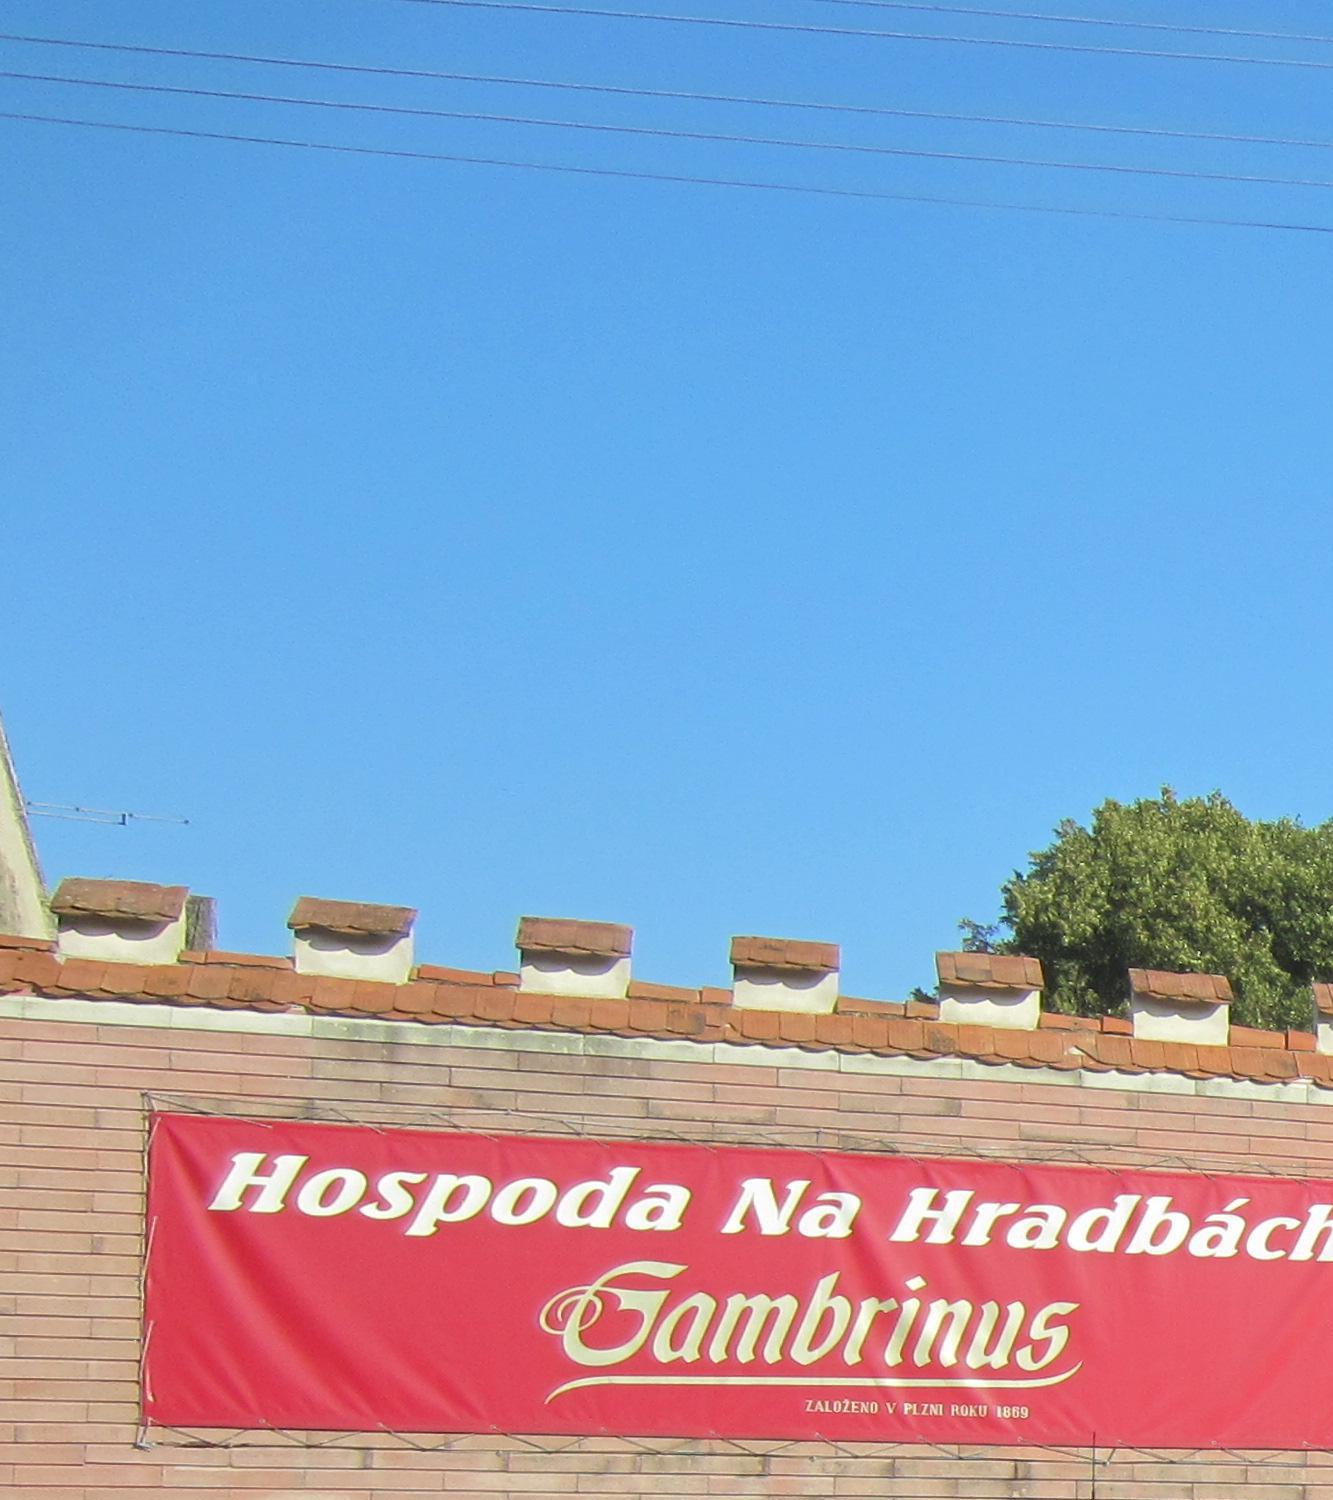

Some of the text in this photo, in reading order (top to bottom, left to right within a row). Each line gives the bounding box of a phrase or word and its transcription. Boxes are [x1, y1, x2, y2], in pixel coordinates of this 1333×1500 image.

[208, 1152, 693, 1238] Hospoda
[721, 1177, 863, 1240] Na
[541, 1259, 1082, 1373] Gambrinus
[805, 1399, 1029, 1419] ZALOŽENO V PLZNI ROKU 1869
